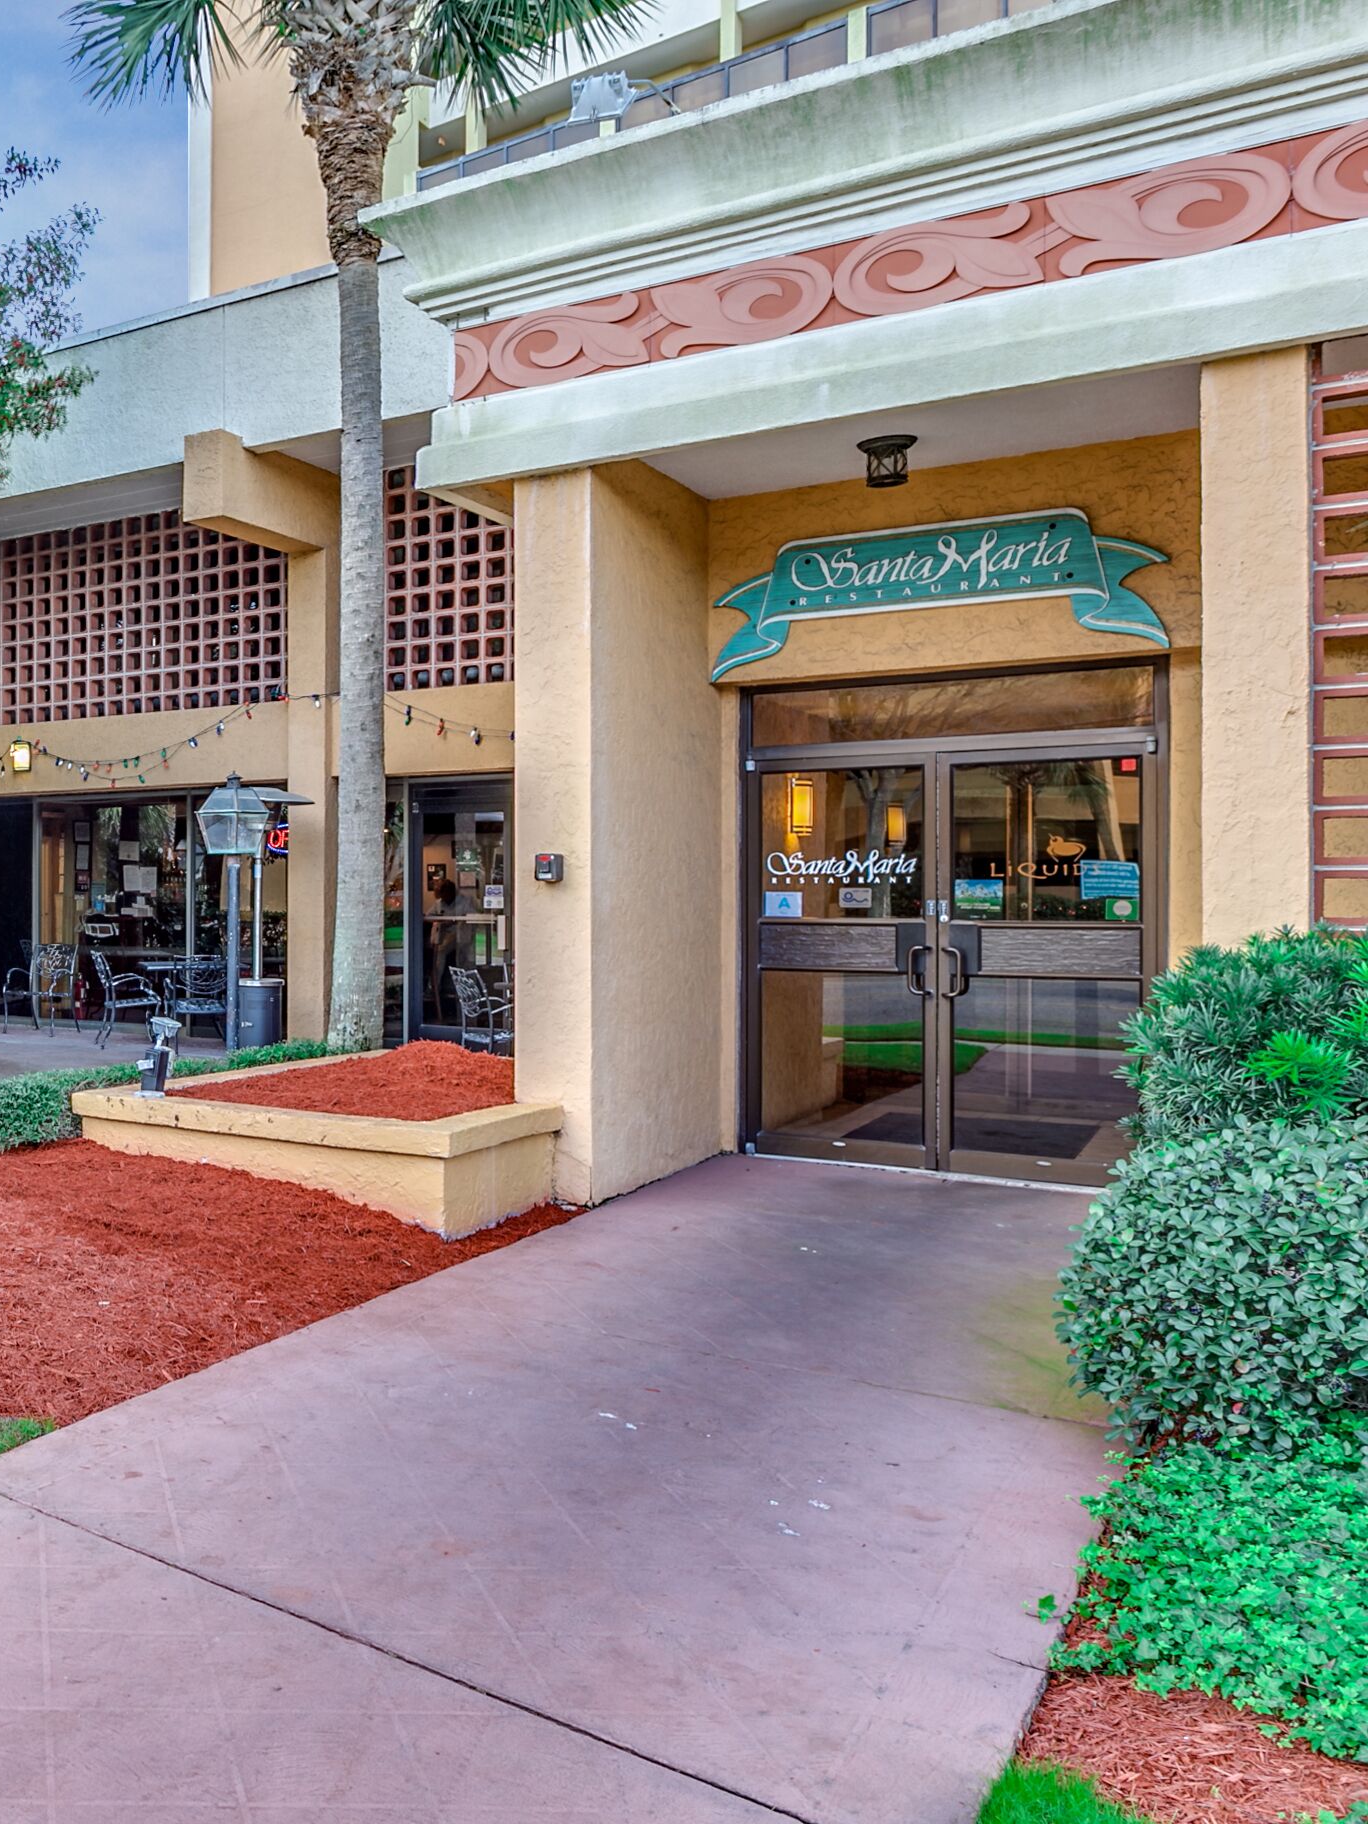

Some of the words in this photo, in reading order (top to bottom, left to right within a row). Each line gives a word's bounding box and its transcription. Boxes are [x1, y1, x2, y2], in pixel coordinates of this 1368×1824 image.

[791, 547, 933, 592] Santa
[927, 529, 1073, 589] Maria
[798, 571, 1063, 606] RESTAURANT
[269, 829, 289, 848] OP
[766, 851, 846, 876] Santa
[835, 849, 917, 883] Maria
[771, 876, 913, 884] RESTAURANT
[778, 896, 791, 909] A
